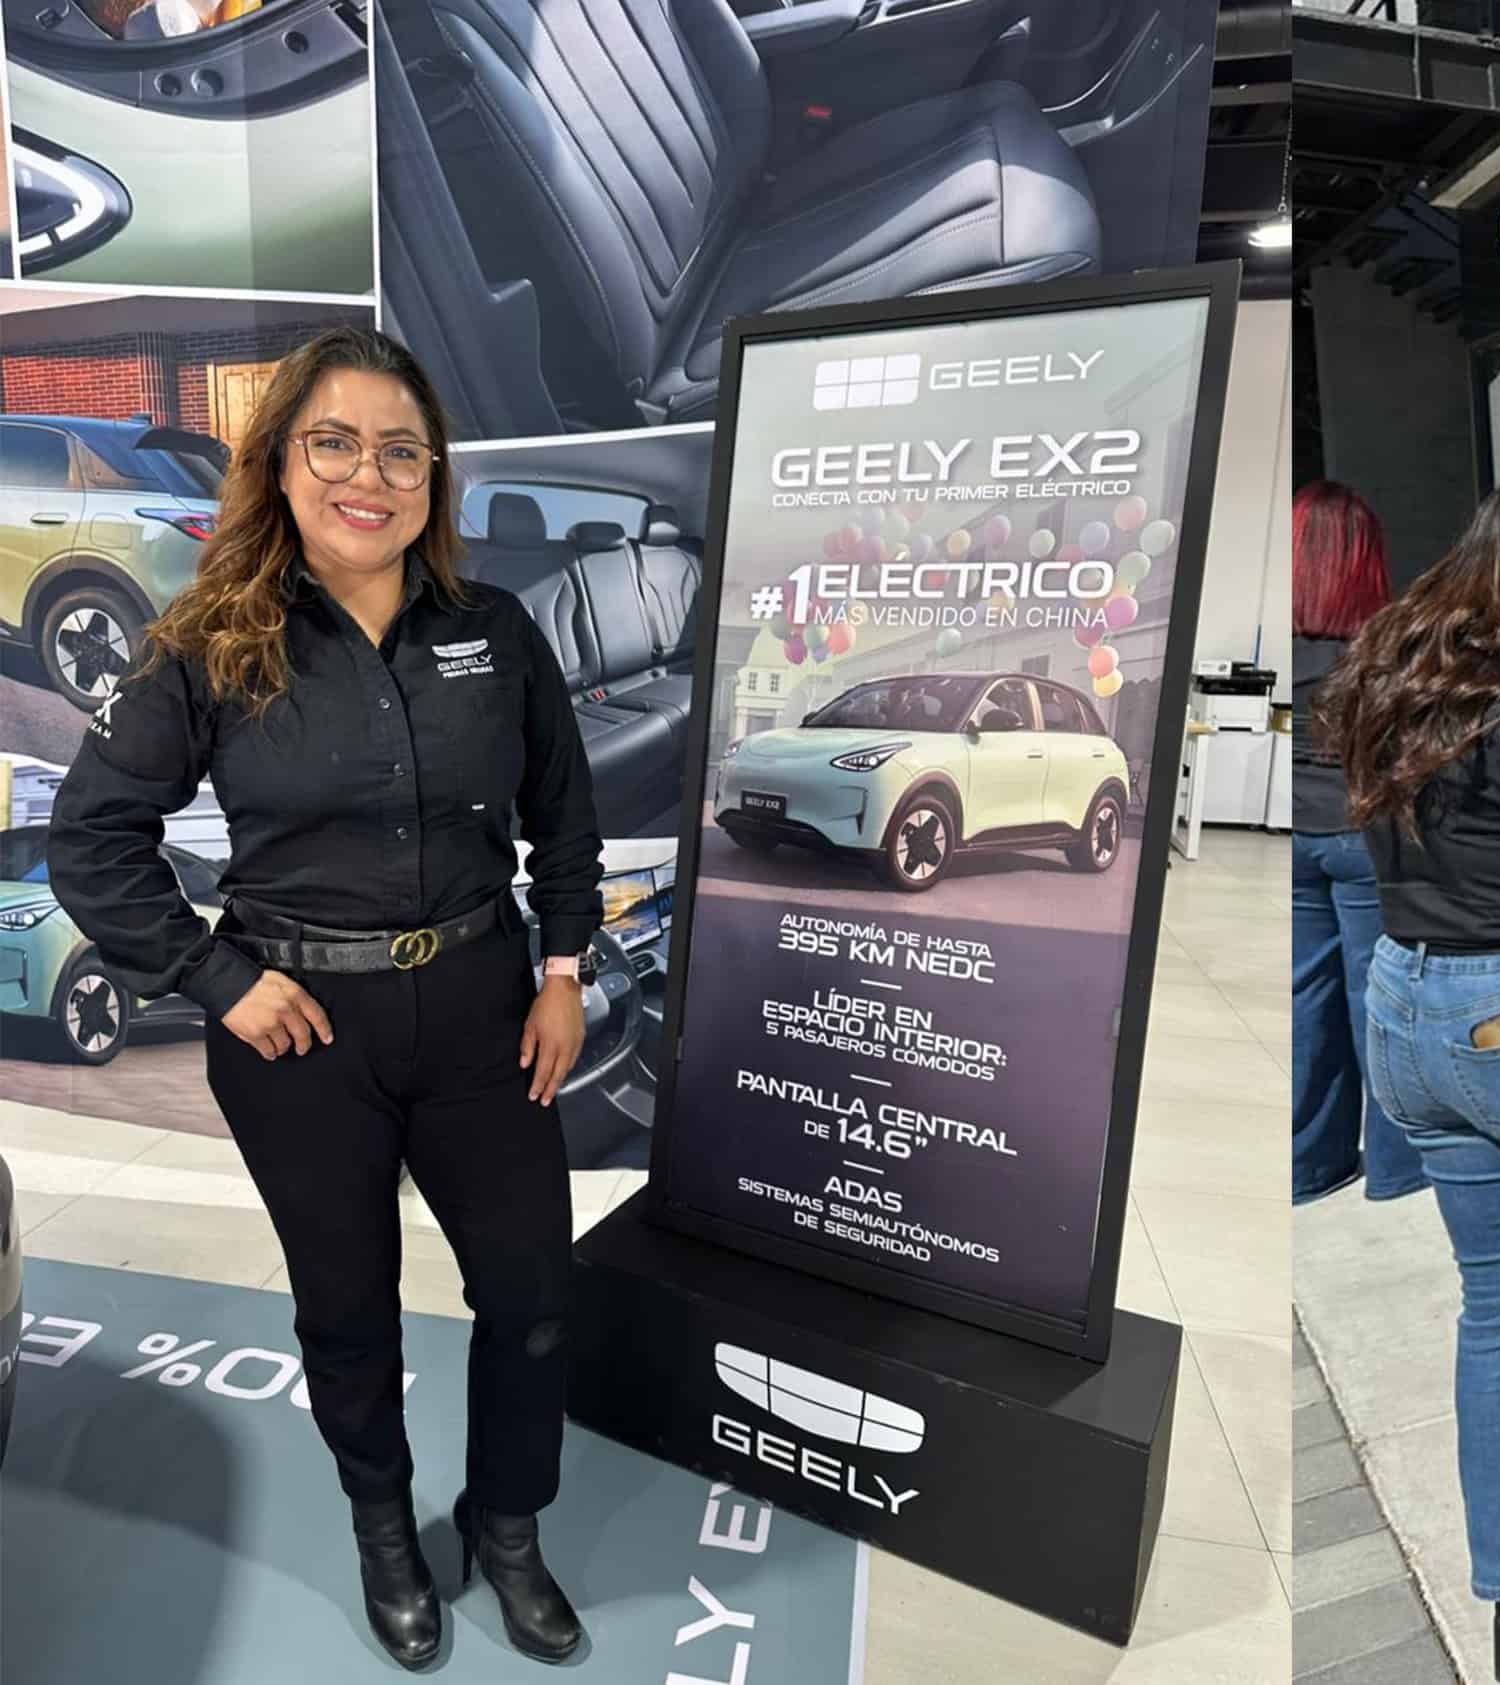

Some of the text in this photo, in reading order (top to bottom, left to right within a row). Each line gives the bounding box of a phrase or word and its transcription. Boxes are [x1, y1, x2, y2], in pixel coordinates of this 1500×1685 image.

[928, 349, 1105, 391] GEELY
[771, 429, 1141, 487] GEELY EX2
[772, 477, 1130, 508] CONECTA CON TU PRIMER ELÉCTRICO
[817, 551, 1114, 600] ELÉCTRICO
[813, 603, 1108, 629] MÁS VENDIDO EN CHINA
[437, 654, 493, 672] GEELY
[778, 928, 997, 984] 395 KM NEDC
[780, 913, 992, 959] AUTONOMÍA DE HASTA
[762, 1000, 1008, 1067] ESPACIO INTERIOR:
[813, 987, 933, 1031] LÍDER EN
[765, 1022, 995, 1081] 5 PASAJEROS CÓMODOS
[736, 1070, 1018, 1157] PANTALLA CENTRAL
[803, 1120, 830, 1139] DE
[824, 1175, 903, 1213] ADAS
[737, 1176, 1000, 1264] SISTEMAS SEMIAUTÓNOMOS
[793, 1211, 931, 1262] DE SEGURIDAD
[712, 1413, 920, 1515] GEELY
